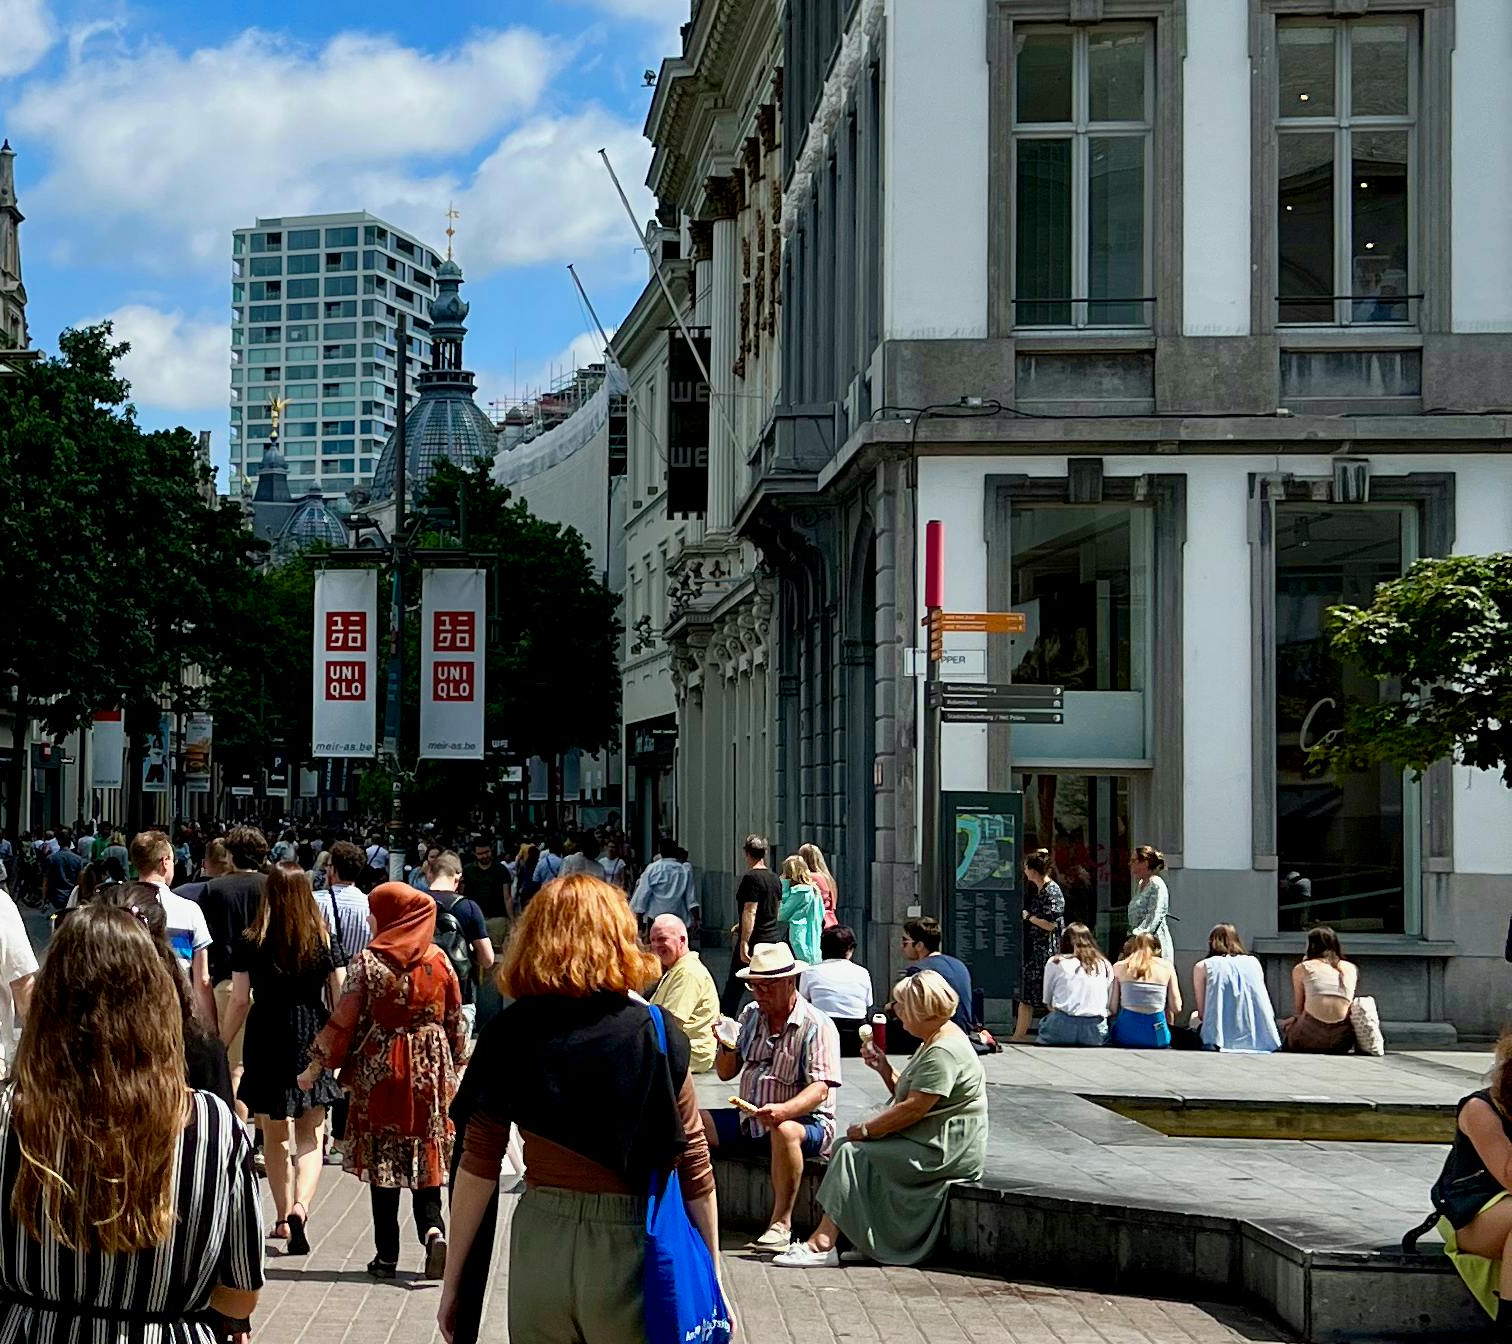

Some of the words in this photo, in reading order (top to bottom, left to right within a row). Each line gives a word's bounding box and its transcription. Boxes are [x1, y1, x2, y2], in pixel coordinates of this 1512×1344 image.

[671, 381, 709, 403] WE
[671, 447, 708, 468] WE
[330, 666, 359, 680] UNI
[437, 666, 467, 680] UNI
[330, 682, 362, 698] QLO
[437, 683, 470, 699] QLO
[315, 741, 373, 752] meir-as.be
[427, 741, 476, 751] meir-as.be
